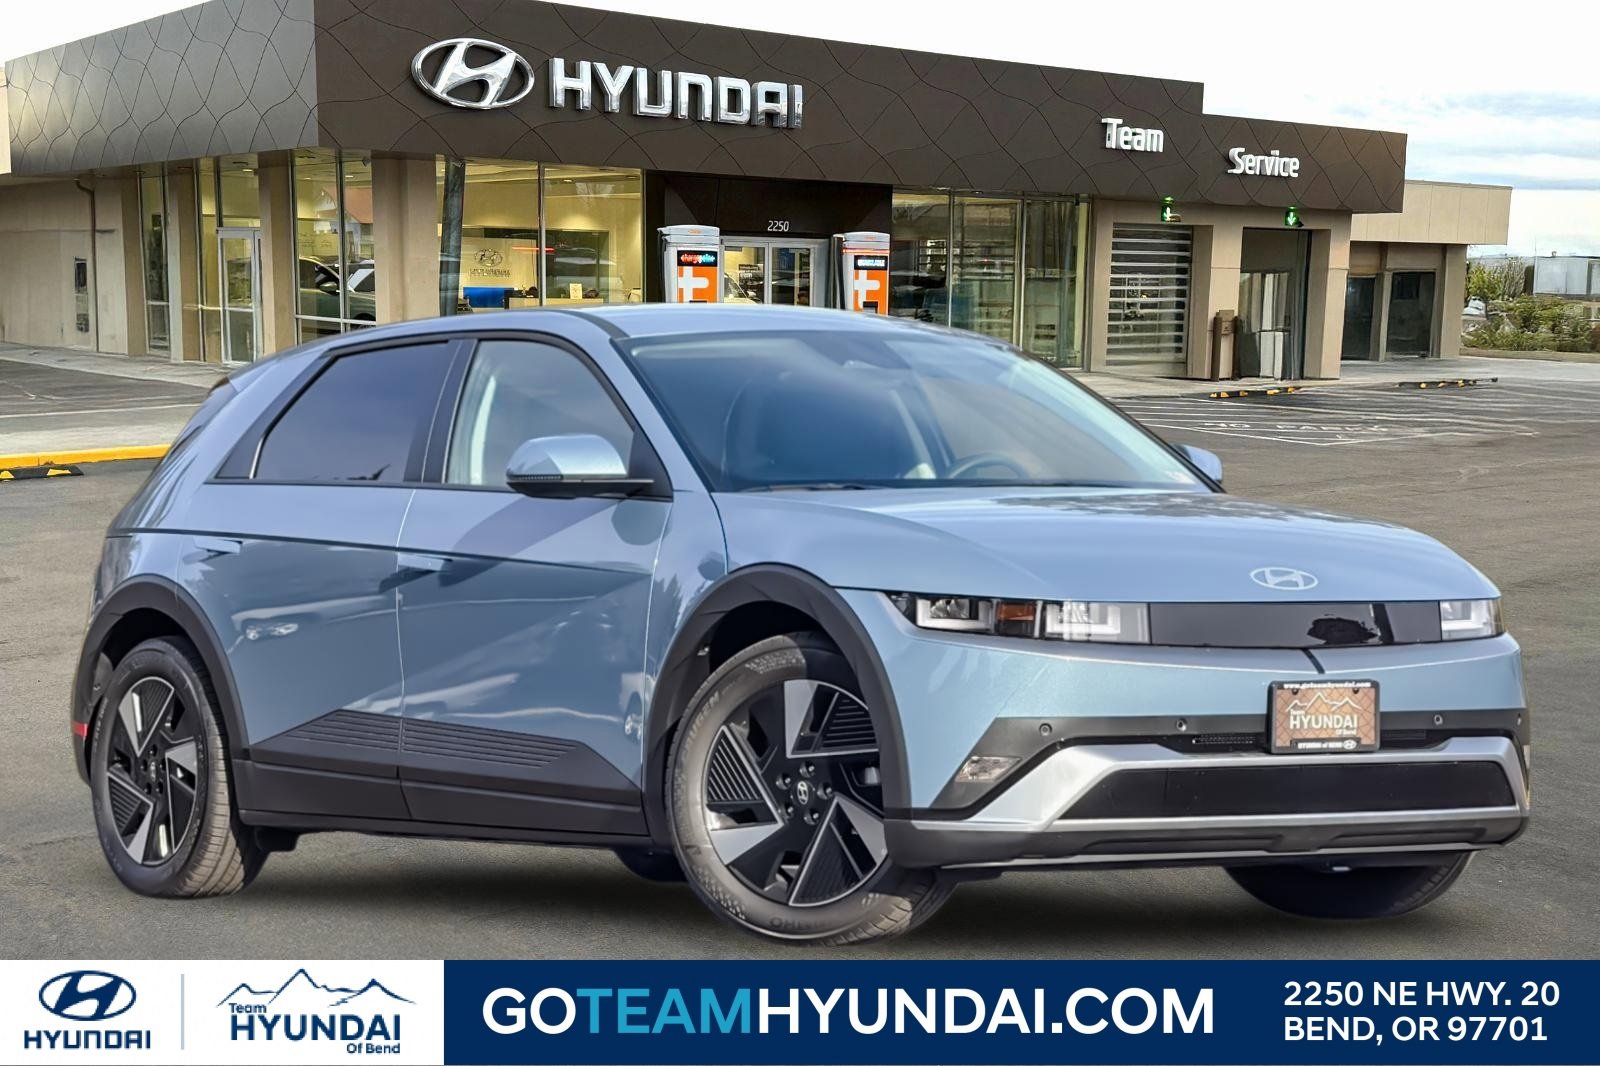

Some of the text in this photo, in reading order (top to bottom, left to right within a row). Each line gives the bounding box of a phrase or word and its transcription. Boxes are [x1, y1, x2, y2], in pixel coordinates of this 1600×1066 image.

[549, 57, 804, 128] HYUNDAI
[1101, 116, 1164, 154] Team
[1228, 146, 1301, 179] Service
[767, 220, 790, 233] 2250
[1289, 714, 1358, 729] HYUNDAI
